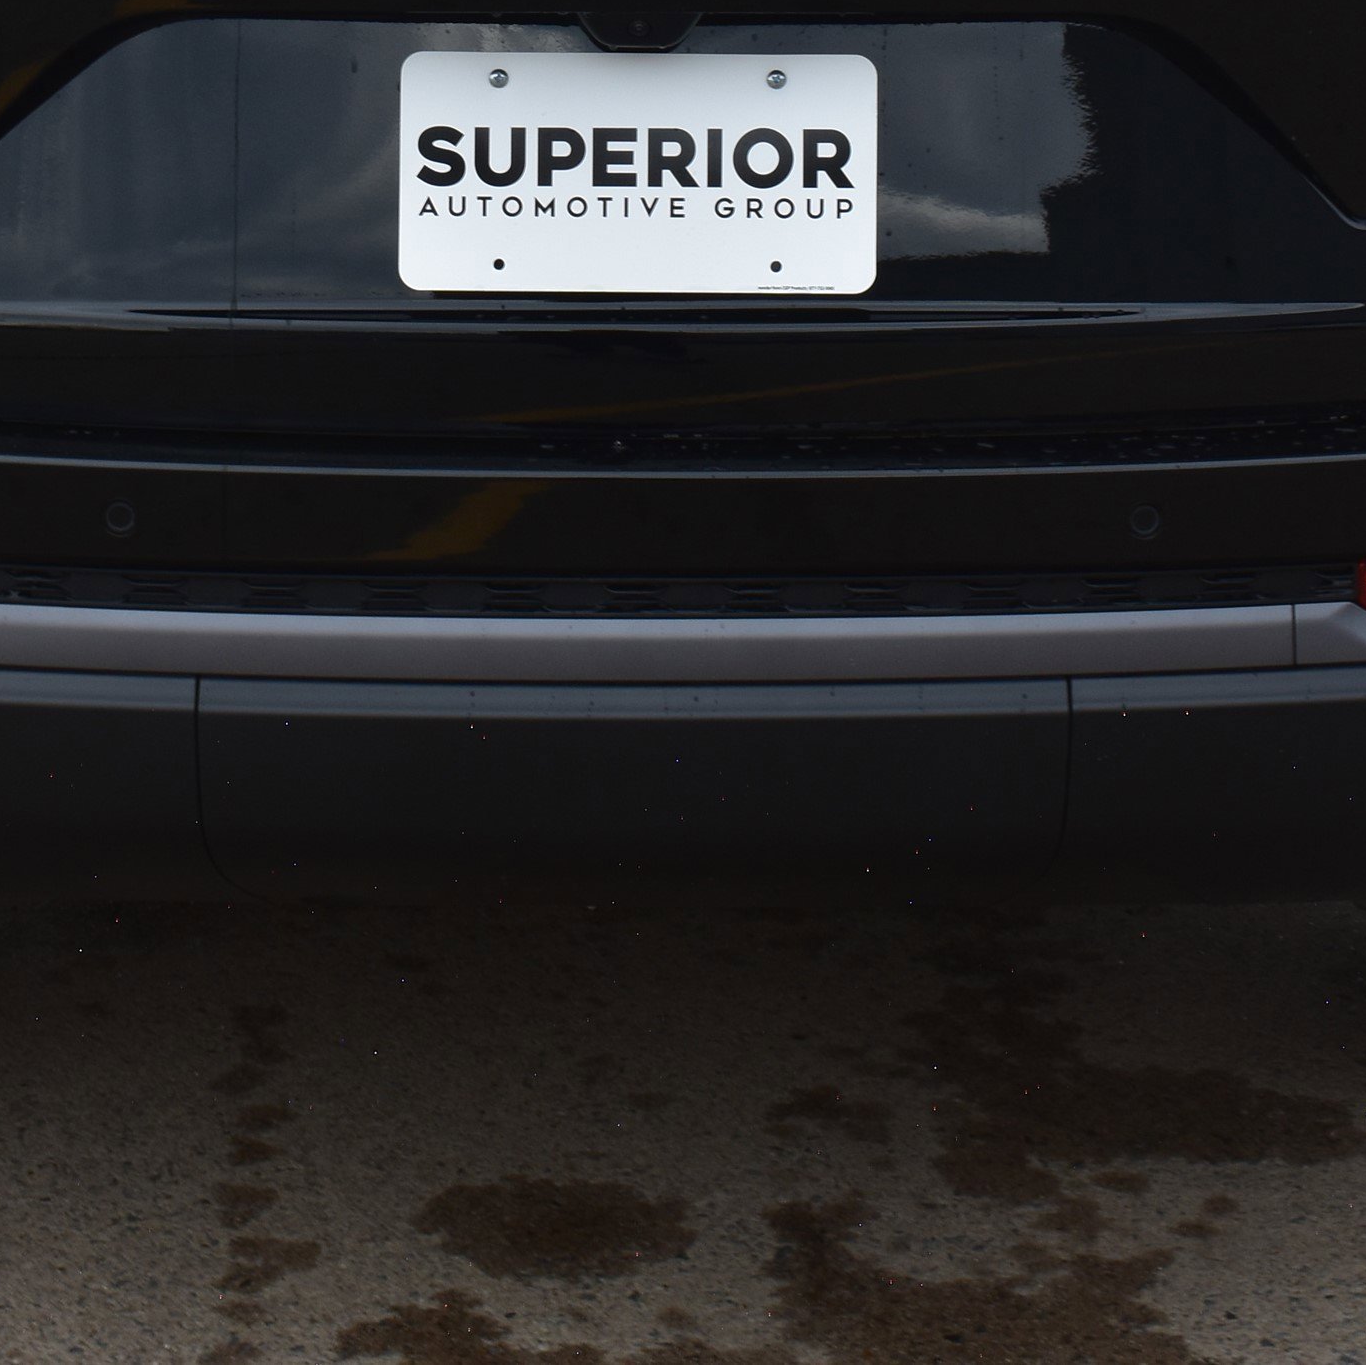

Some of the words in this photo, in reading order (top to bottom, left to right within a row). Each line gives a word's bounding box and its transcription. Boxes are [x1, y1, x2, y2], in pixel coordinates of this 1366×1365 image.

[416, 125, 855, 189] SUPERIOR
[418, 195, 687, 219] AUTOMOTIVE
[714, 196, 854, 220] GROUP
